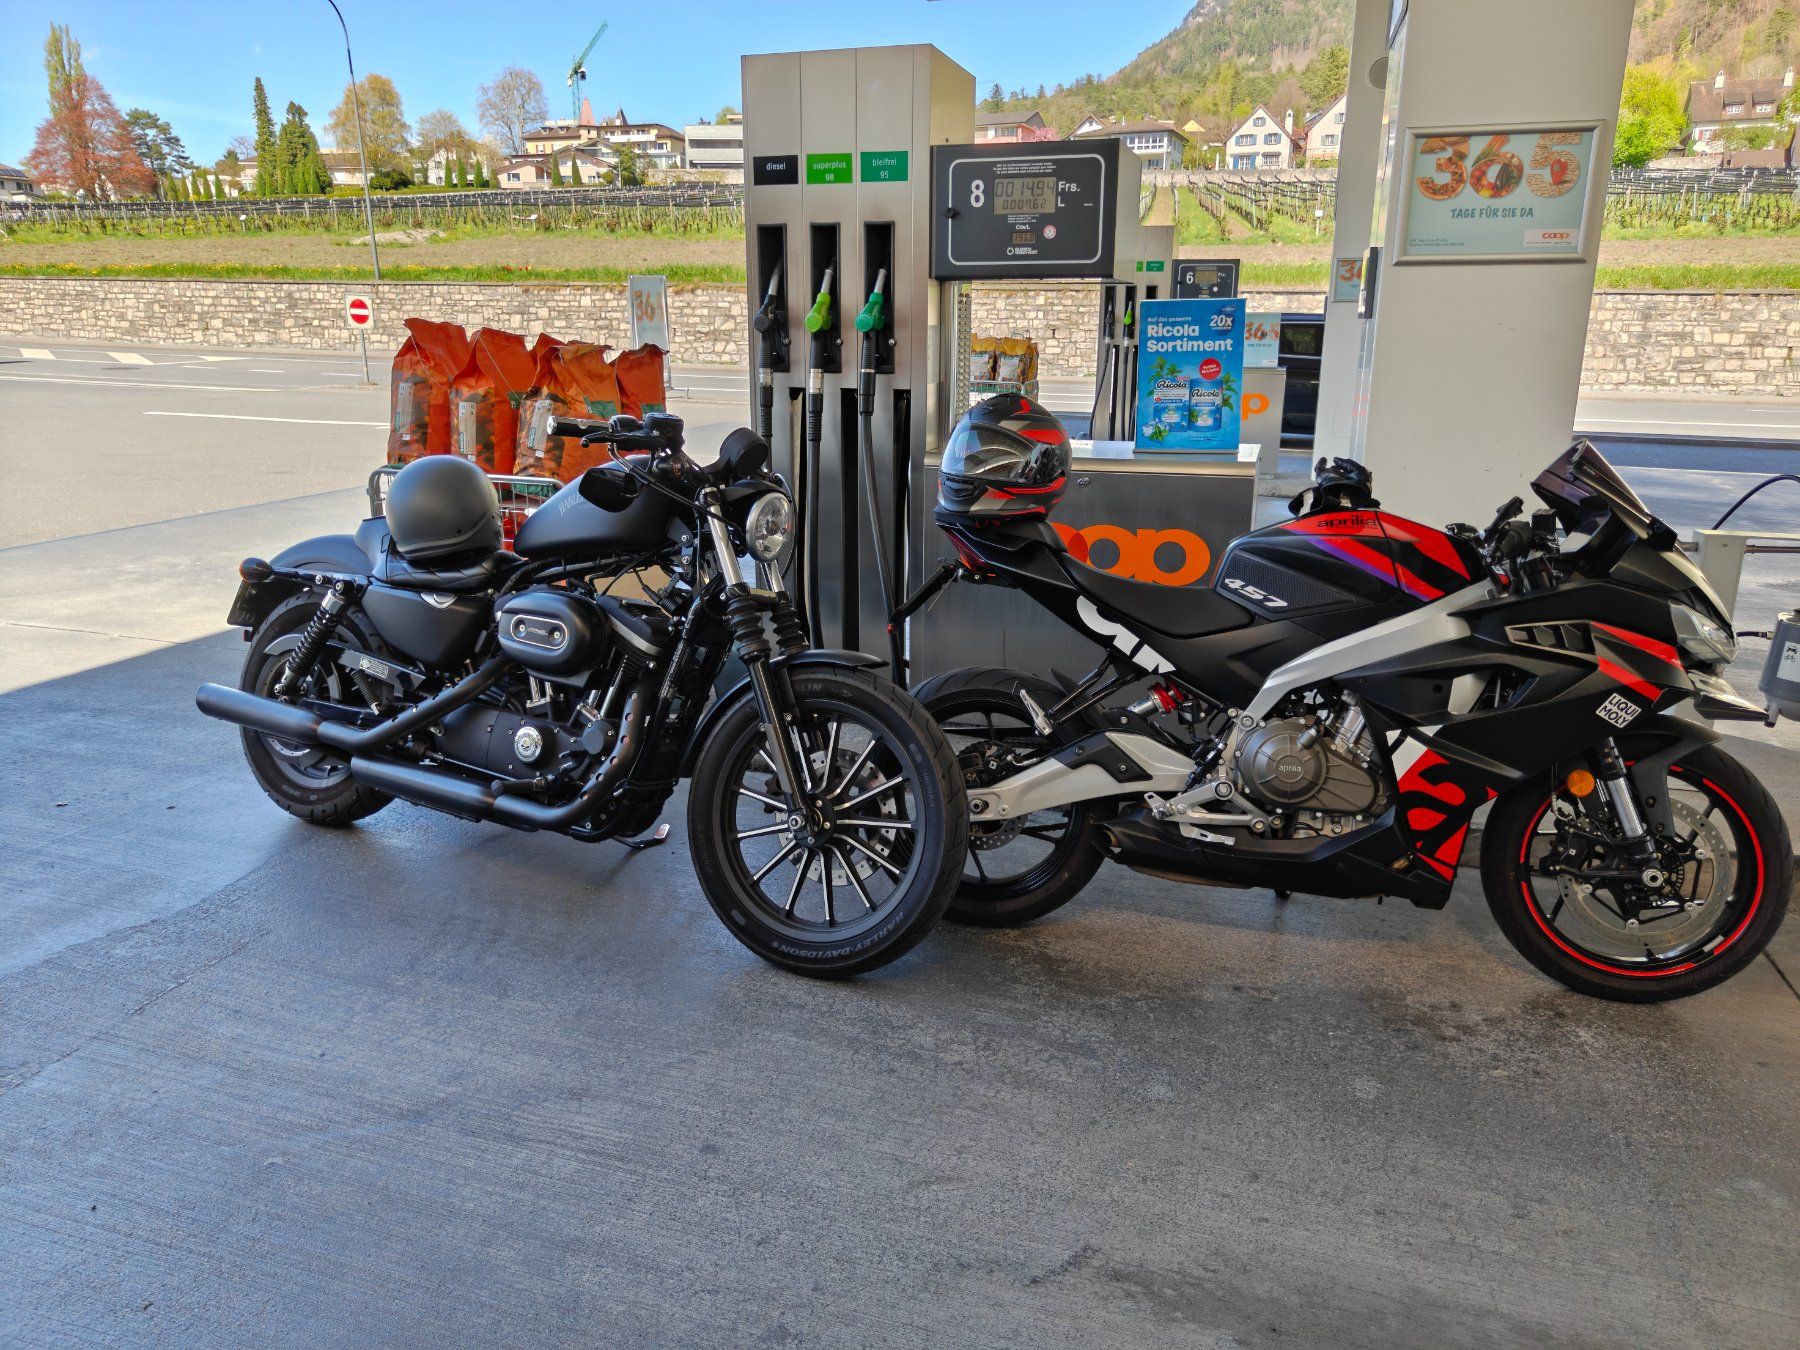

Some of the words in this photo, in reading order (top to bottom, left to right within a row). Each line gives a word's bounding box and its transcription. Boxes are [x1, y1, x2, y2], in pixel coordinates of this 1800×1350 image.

[766, 161, 786, 171] diesel
[812, 161, 847, 170] superplus
[872, 157, 897, 167] bleifrei
[1416, 132, 1583, 201] 365
[825, 173, 835, 182] 98
[879, 170, 889, 179] 95
[1058, 181, 1081, 192] Frs.
[970, 179, 985, 208] 8
[1057, 196, 1066, 207] L
[1451, 208, 1476, 219] TAGE
[1479, 206, 1499, 219] FÜR
[1501, 207, 1517, 218] SIE
[1520, 207, 1534, 218] DA
[1542, 232, 1569, 240] coop
[1186, 272, 1194, 284] 6
[1209, 315, 1233, 327] 20x
[1147, 323, 1200, 337] Ricola
[1146, 338, 1233, 353] Sortiment
[1156, 379, 1187, 389] Ricola
[1191, 388, 1219, 398] Ricola
[1317, 514, 1377, 528] aprilia
[1224, 578, 1288, 607] 457
[1608, 695, 1639, 718] LIQUI
[1598, 705, 1630, 726] MOLY
